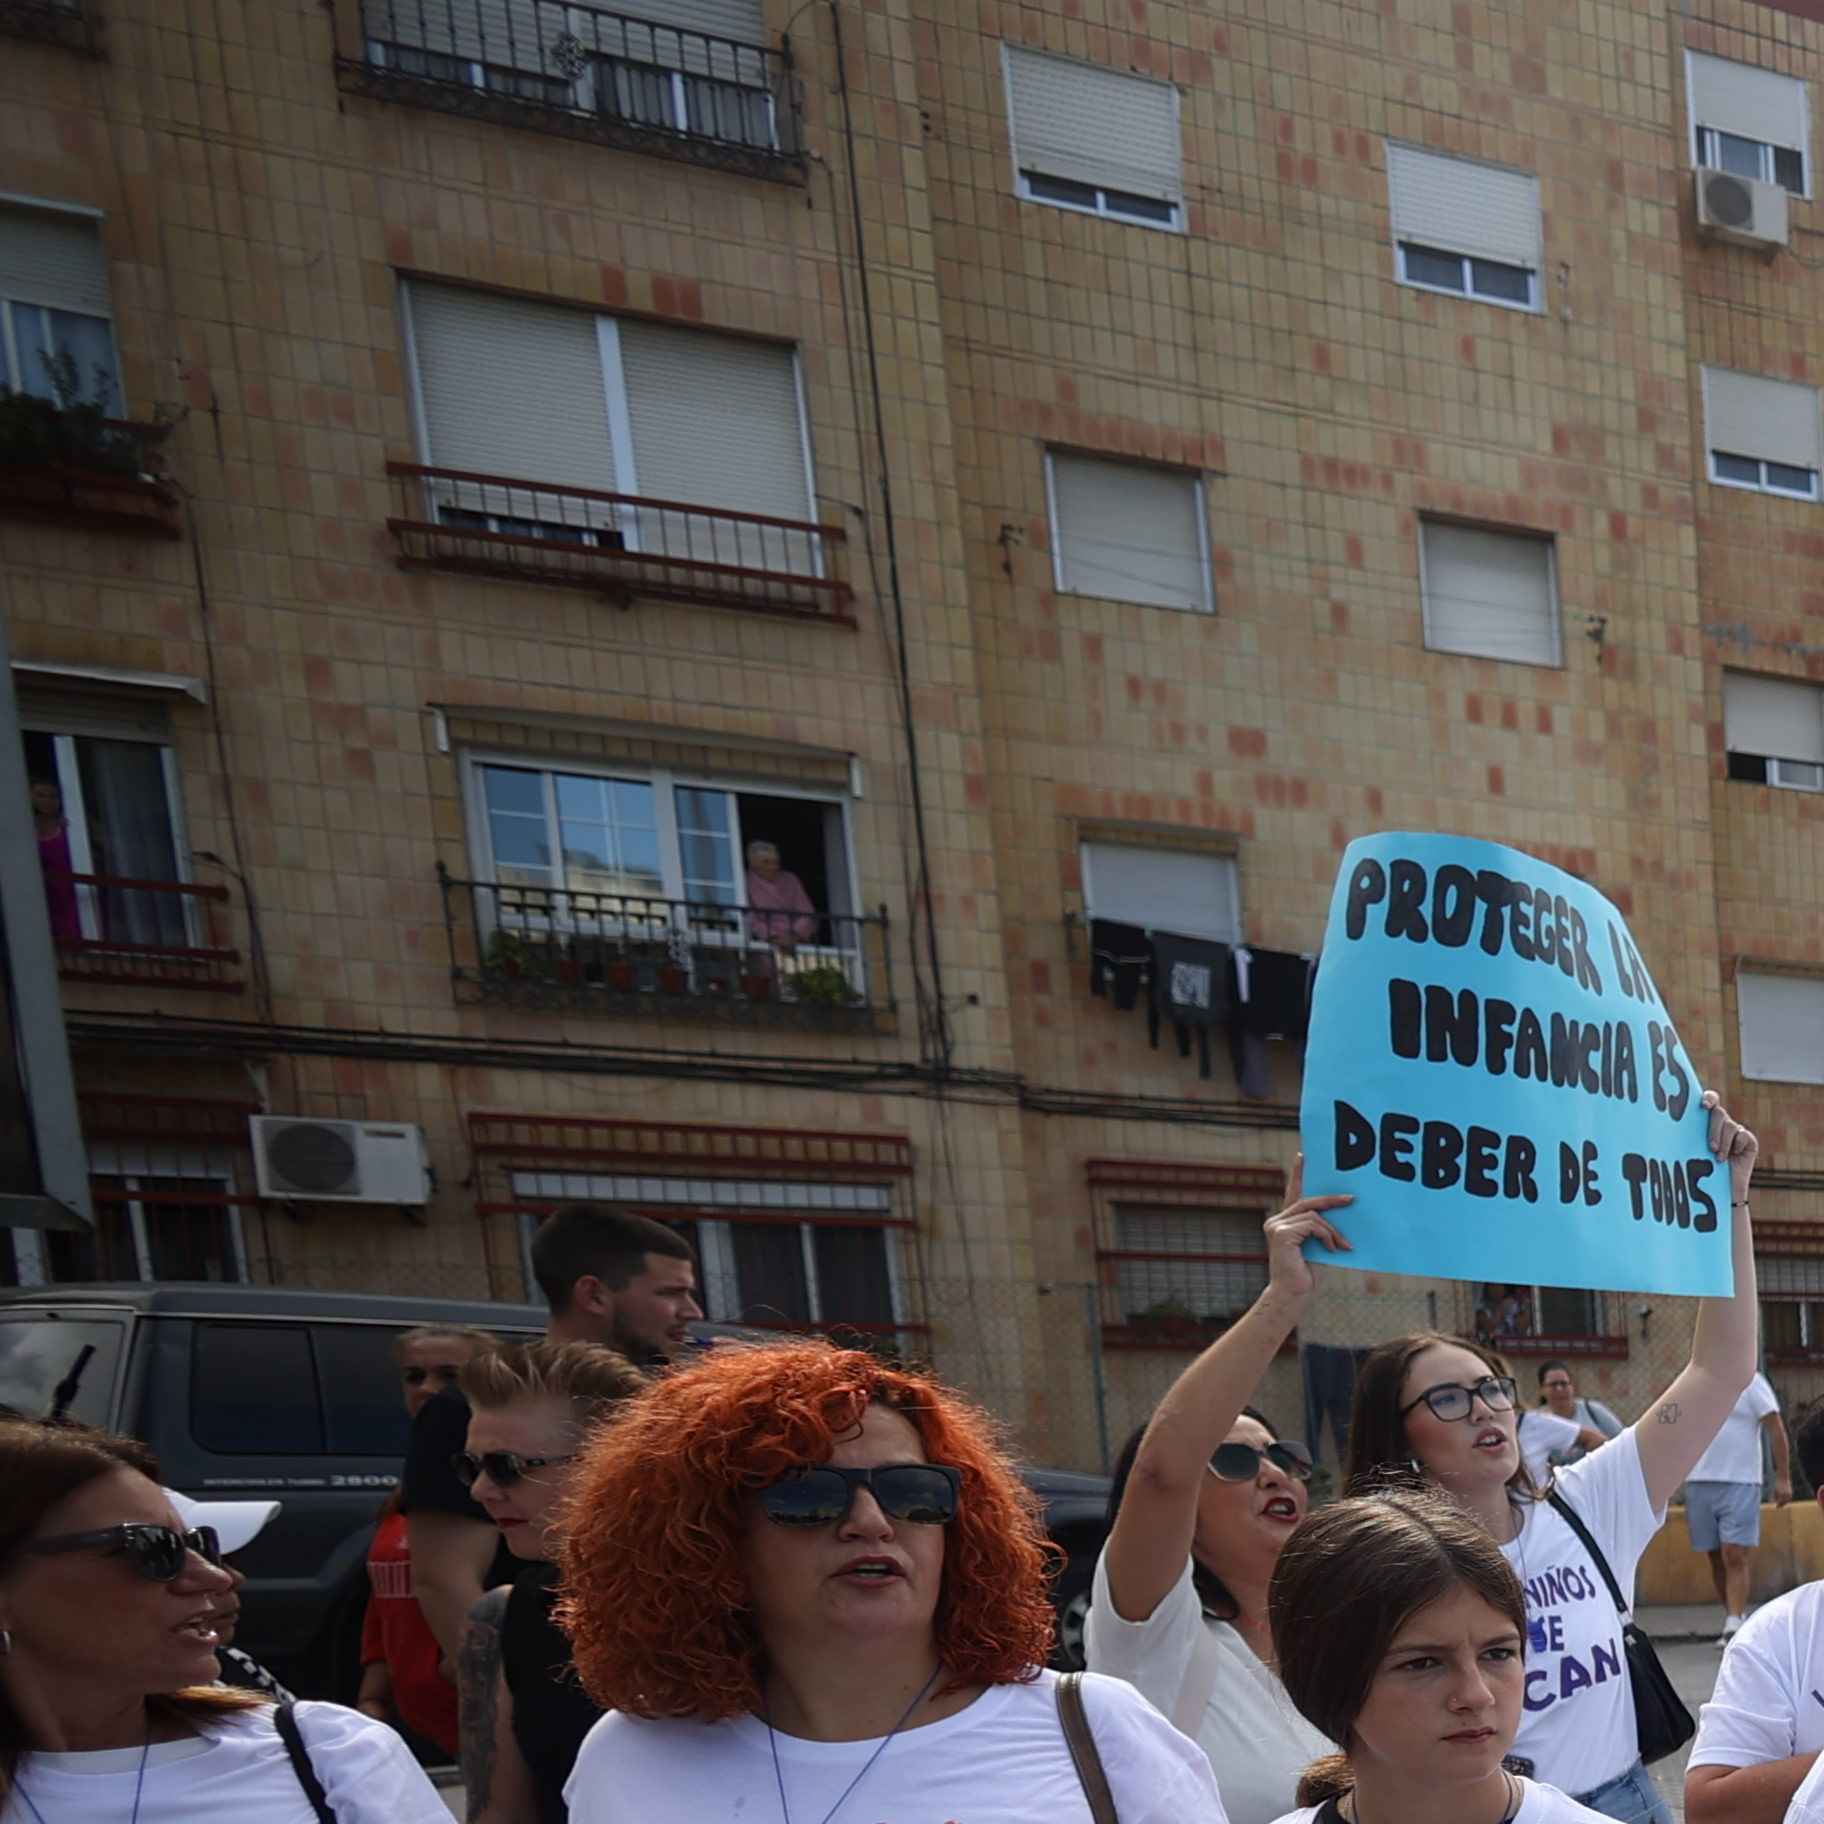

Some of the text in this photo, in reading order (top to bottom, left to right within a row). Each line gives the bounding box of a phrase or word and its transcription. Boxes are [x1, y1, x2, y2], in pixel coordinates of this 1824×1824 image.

[1345, 858, 1655, 1004] PROTEGER LA
[1388, 978, 1690, 1122] INFANCIA ES
[1334, 1099, 1718, 1233] DEBER DE TODOS
[1524, 1564, 1596, 1610] NIÑOS
[1522, 1637, 1621, 1712] CAN
